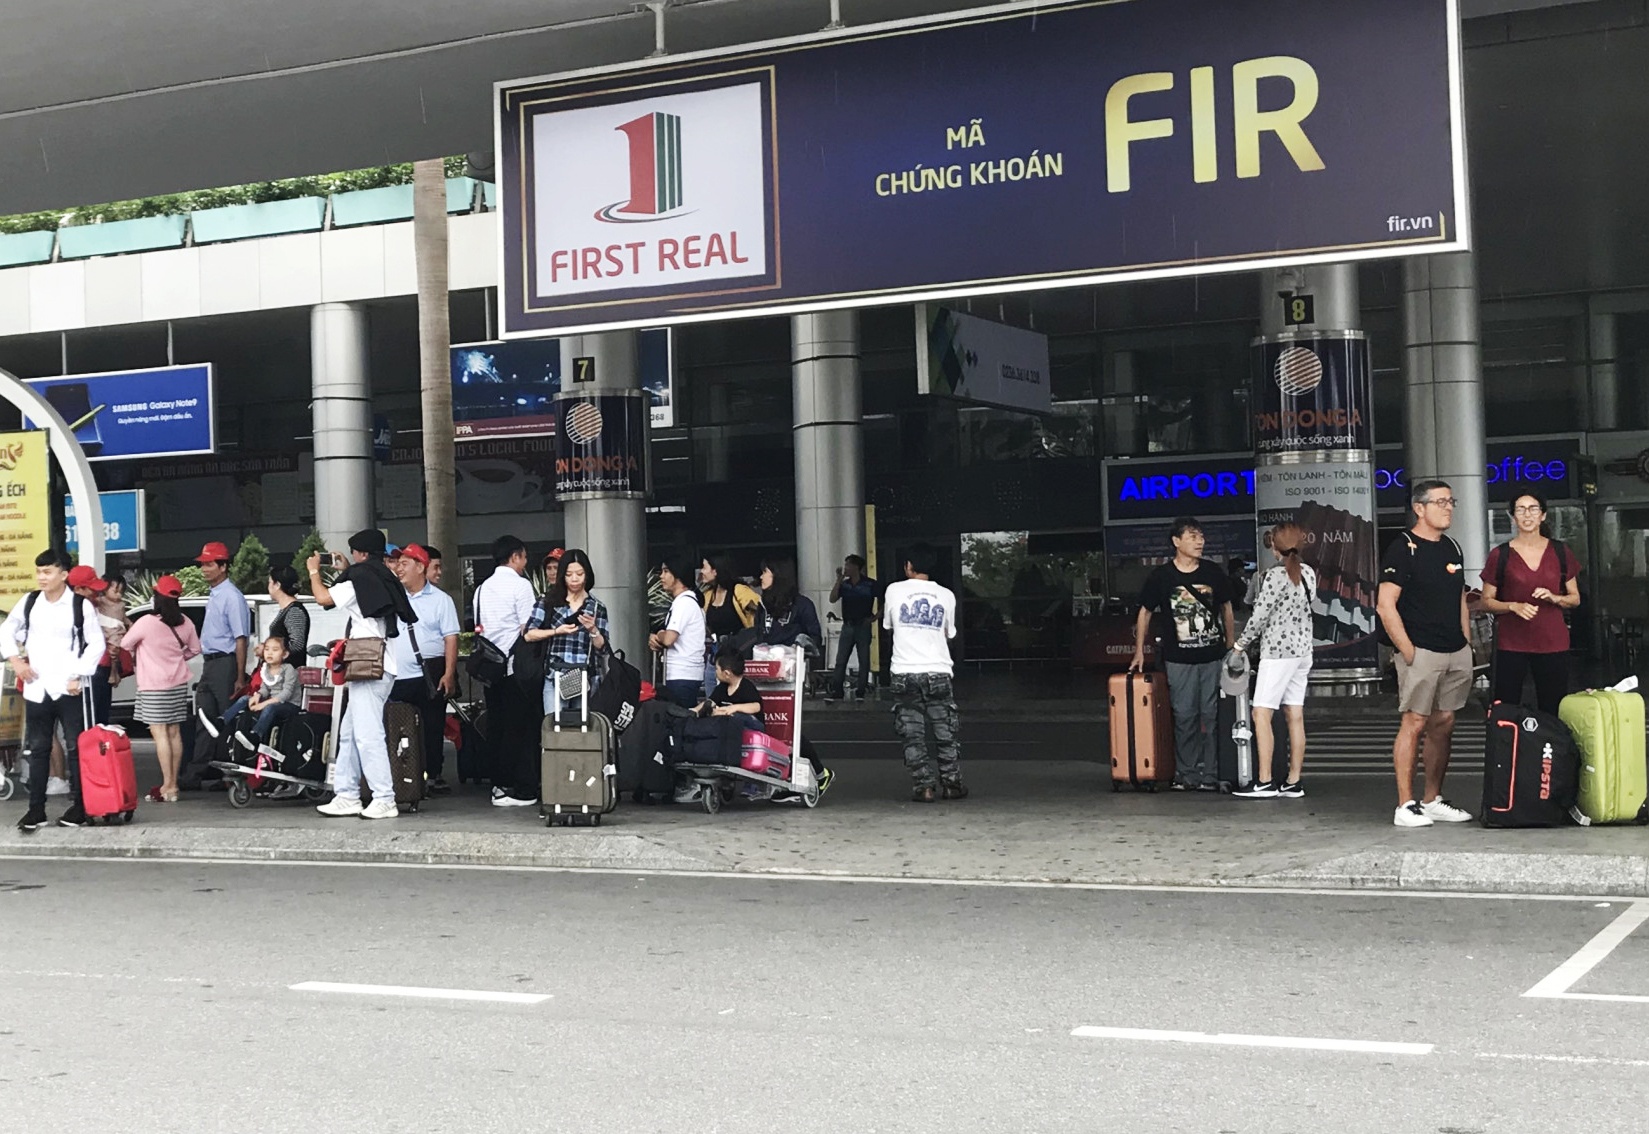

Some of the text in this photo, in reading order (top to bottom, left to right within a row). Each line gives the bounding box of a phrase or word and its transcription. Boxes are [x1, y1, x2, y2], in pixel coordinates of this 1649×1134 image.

[945, 118, 986, 151] MÃ
[1105, 55, 1326, 194] FIR
[875, 151, 1064, 198] CHỨNG KHOÁN
[1386, 214, 1433, 233] fir.vn
[550, 230, 750, 284] FIRST REAL
[1291, 298, 1306, 322] 8
[577, 359, 589, 380] 7
[112, 398, 197, 413] SAMSUNG Galaxy Note9
[1308, 433, 1332, 447] sống
[1333, 433, 1355, 445] xanh
[1119, 469, 1255, 501] AIRPORT
[1284, 487, 1301, 496] ISO
[1334, 486, 1350, 495] ISO
[1322, 528, 1354, 544] NĂM
